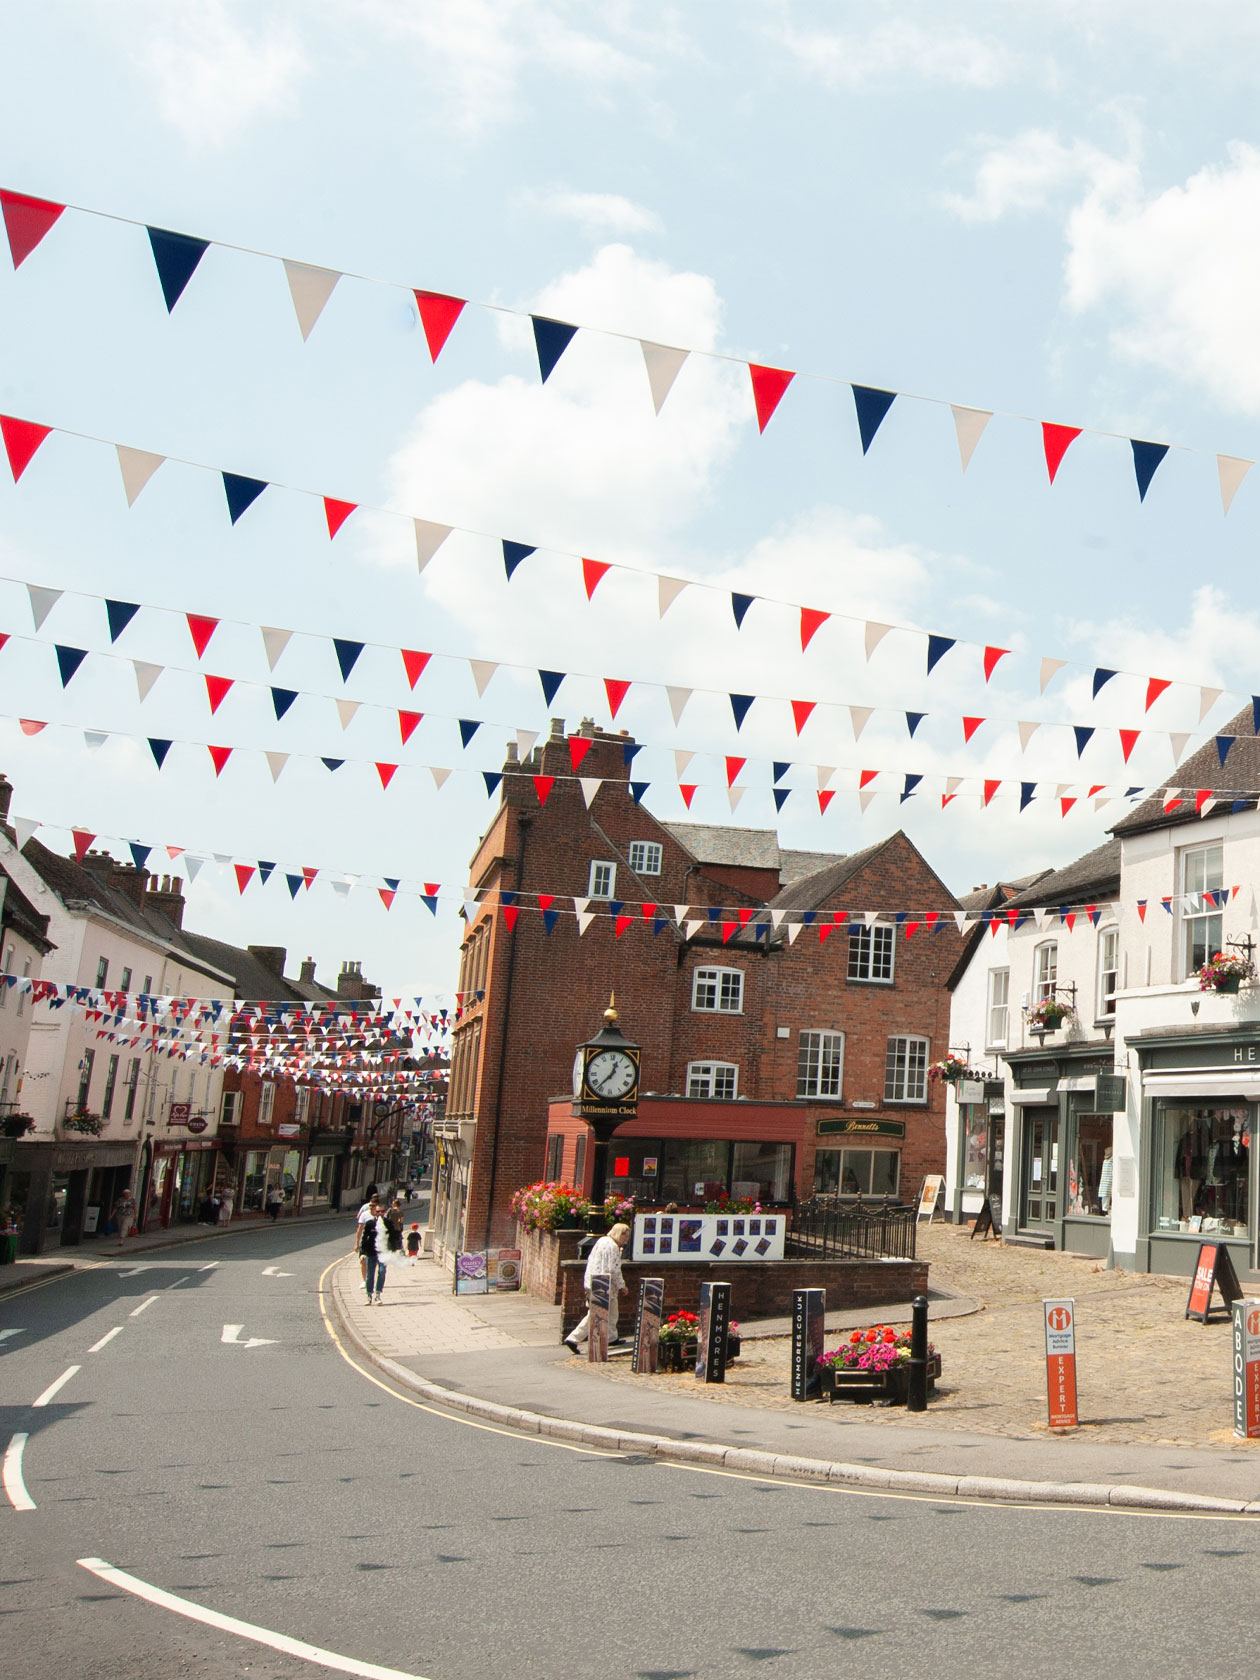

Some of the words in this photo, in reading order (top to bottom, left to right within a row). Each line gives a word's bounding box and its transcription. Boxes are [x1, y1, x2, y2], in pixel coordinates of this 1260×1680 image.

[582, 1106, 618, 1114] Millennium
[618, 1106, 637, 1114] Clock
[845, 1120, 880, 1133] Bennetts
[1197, 1266, 1213, 1283] SALE
[713, 1292, 725, 1377] HENMORES
[795, 1295, 803, 1395] HENMORES.CO.UK
[1058, 1357, 1066, 1412] EXPERT
[1234, 1309, 1243, 1421] ABODE
